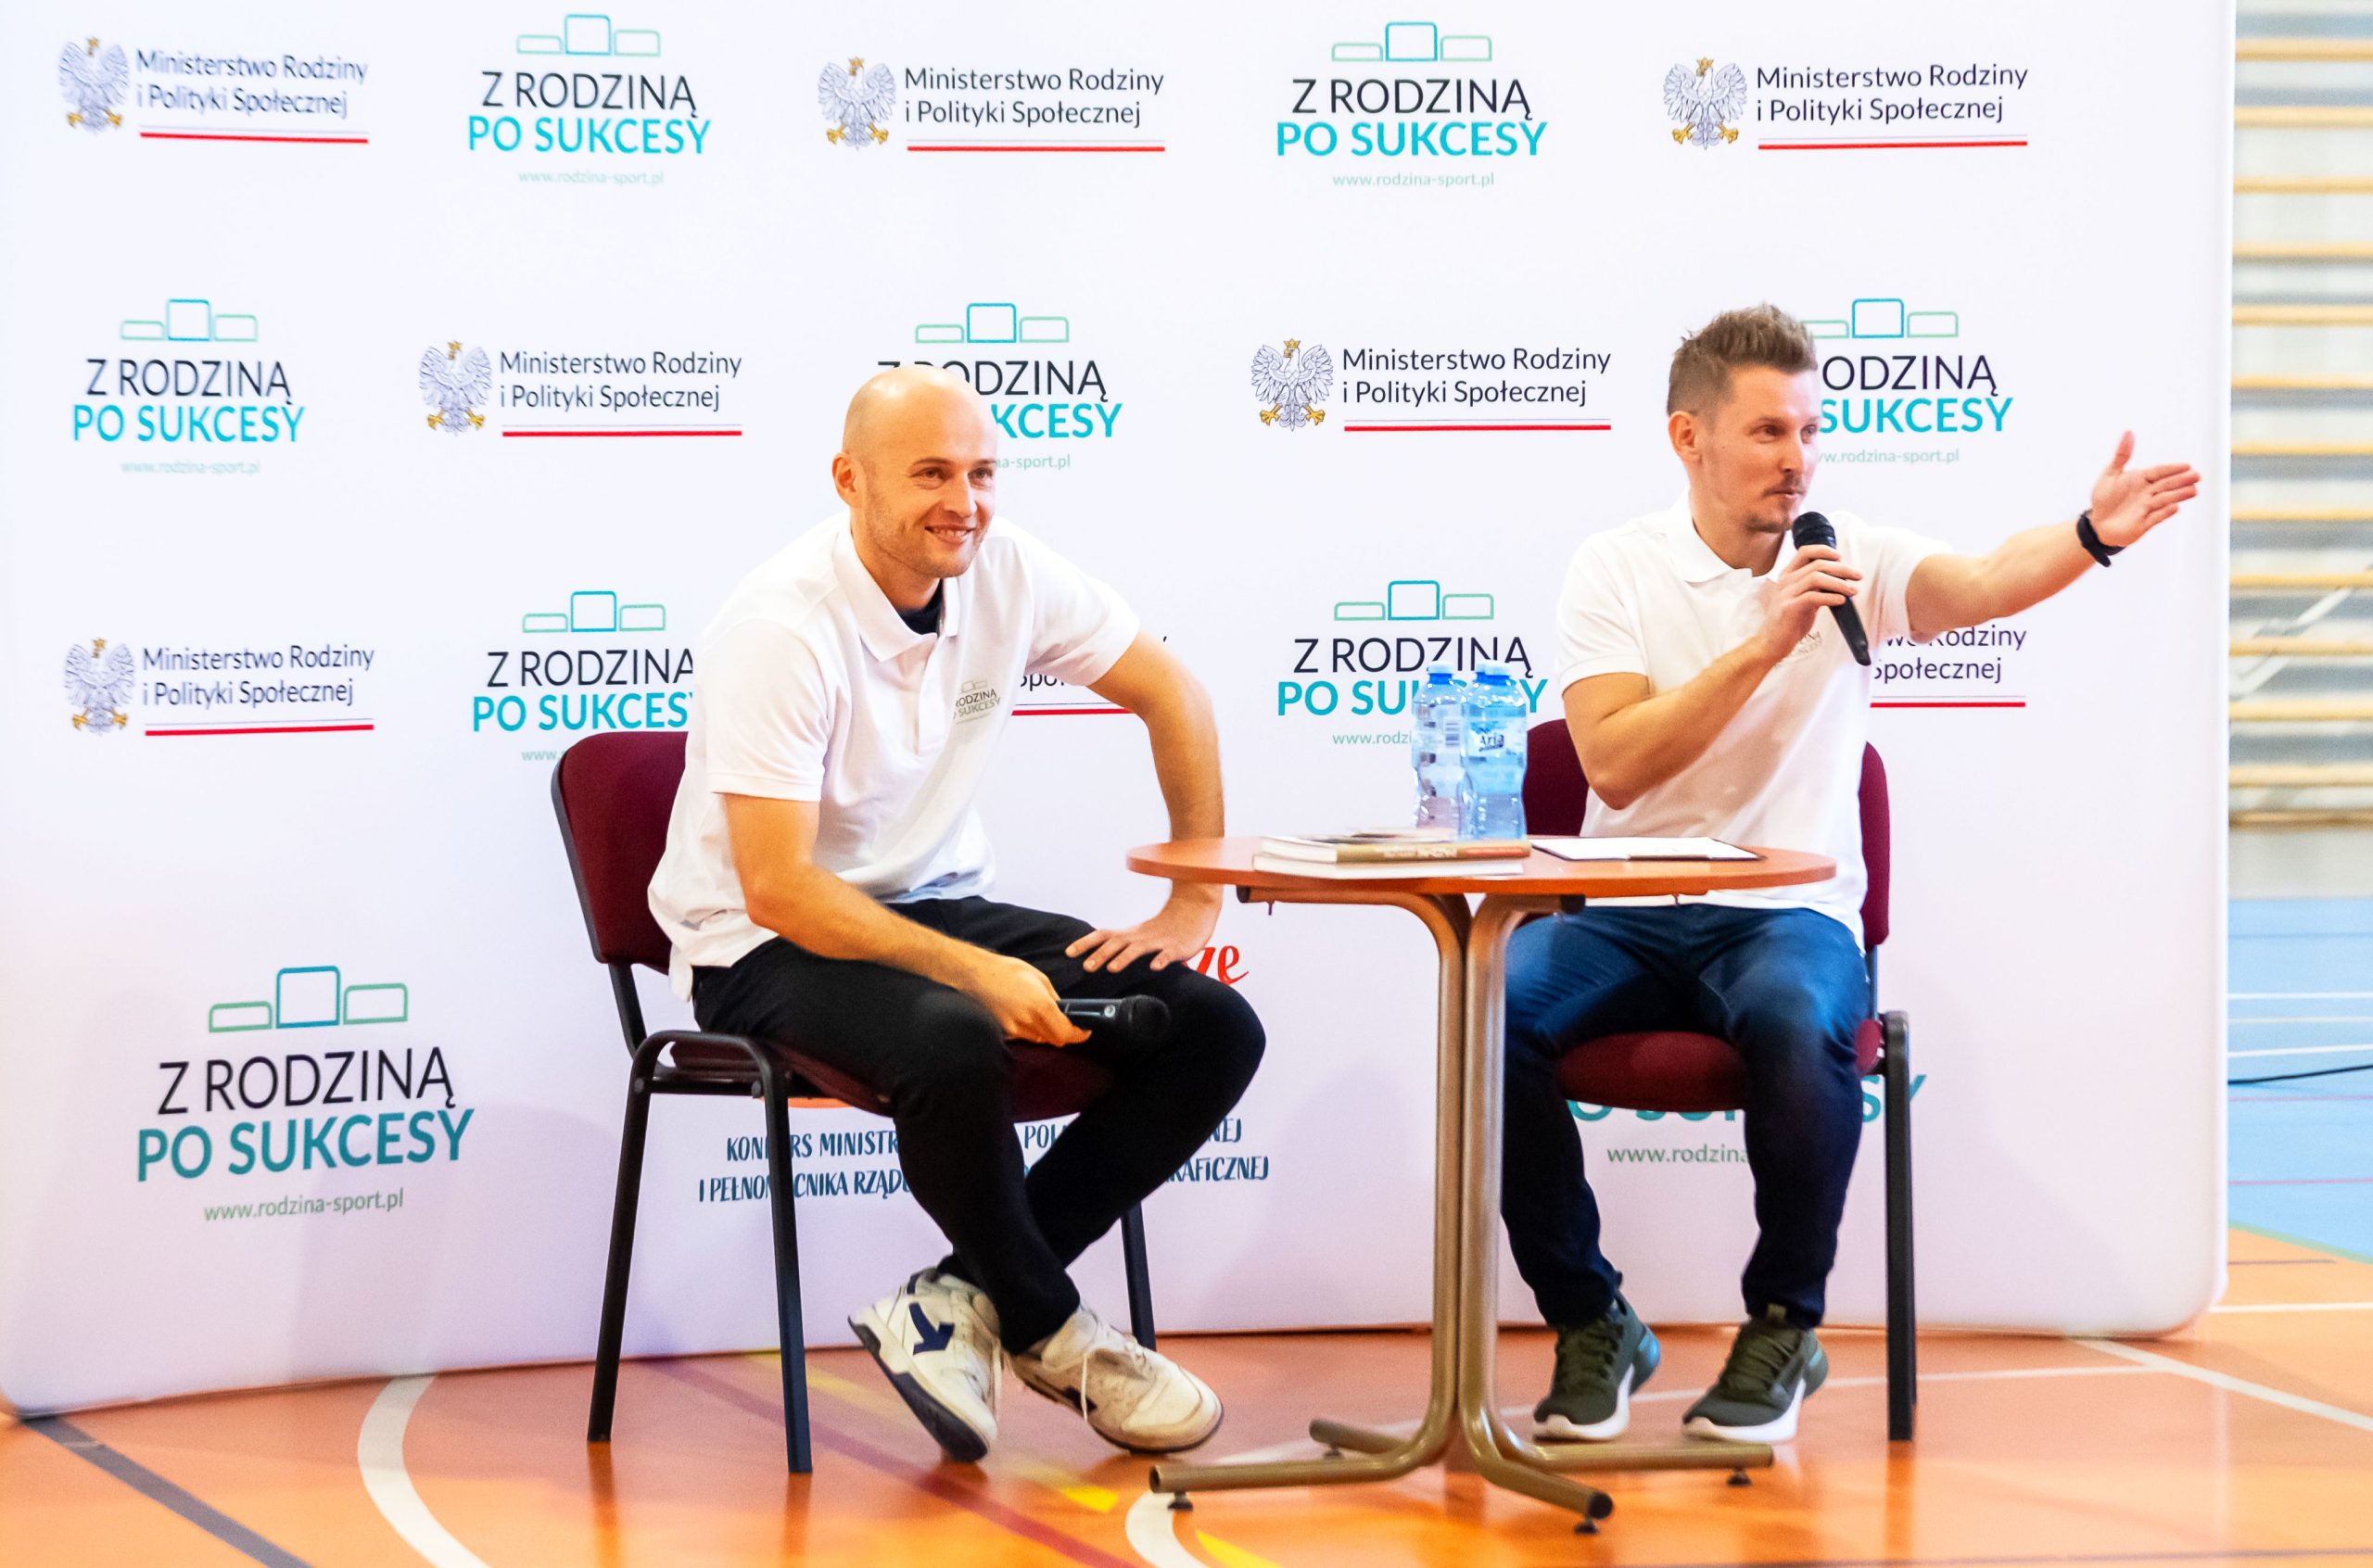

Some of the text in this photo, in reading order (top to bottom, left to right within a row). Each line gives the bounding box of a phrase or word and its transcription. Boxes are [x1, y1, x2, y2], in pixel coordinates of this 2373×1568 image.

[138, 50, 368, 84] Ministerstwo Rodziny
[906, 68, 1163, 95] Ministerstwo Rodziny
[1758, 64, 2027, 89] Ministerstwo Rodziny
[135, 83, 349, 117] i Polityki Społecznej
[482, 71, 697, 118] Z RODZINĄ
[1292, 79, 1532, 120] Z RODZINĄ
[1757, 96, 2001, 125] i Polityki Społecznej
[905, 100, 1139, 128] i Polityki Społecznej
[469, 113, 710, 154] PO SUKCESY
[1277, 122, 1546, 156] PO SUKCESY
[518, 171, 664, 186] www.rodzina-sport.pl
[1333, 172, 1493, 188] www.rodzina-sport.pl
[501, 351, 742, 377] Ministerstwo Rodziny
[1344, 348, 1610, 373] Ministerstwo Rodziny
[1822, 355, 1998, 397] ODZINĄ
[87, 359, 290, 405] Z RODZINĄ
[499, 385, 718, 411] i Polityki Społecznej
[1342, 380, 1585, 407] i Polityki Społecznej
[74, 405, 304, 442] PO SUKCESY
[991, 402, 1123, 438] KCESY
[1819, 397, 2013, 433] SUKCESY
[121, 461, 260, 474] www.rodzina-sport.pl
[145, 645, 374, 670] Ministerstwo Rodziny
[488, 651, 508, 687] Z
[1294, 637, 1533, 680] Z RODZINĄ
[142, 678, 352, 707] i Polityki Społecznej
[1278, 681, 1338, 715] PO
[474, 691, 692, 731] PO SUKCES
[158, 1046, 456, 1115] Z RODZINĄ
[137, 1108, 475, 1182] PO SUKCESY
[203, 1187, 404, 1221] www.rodzina-sport.pl
[698, 1179, 705, 1203] I
